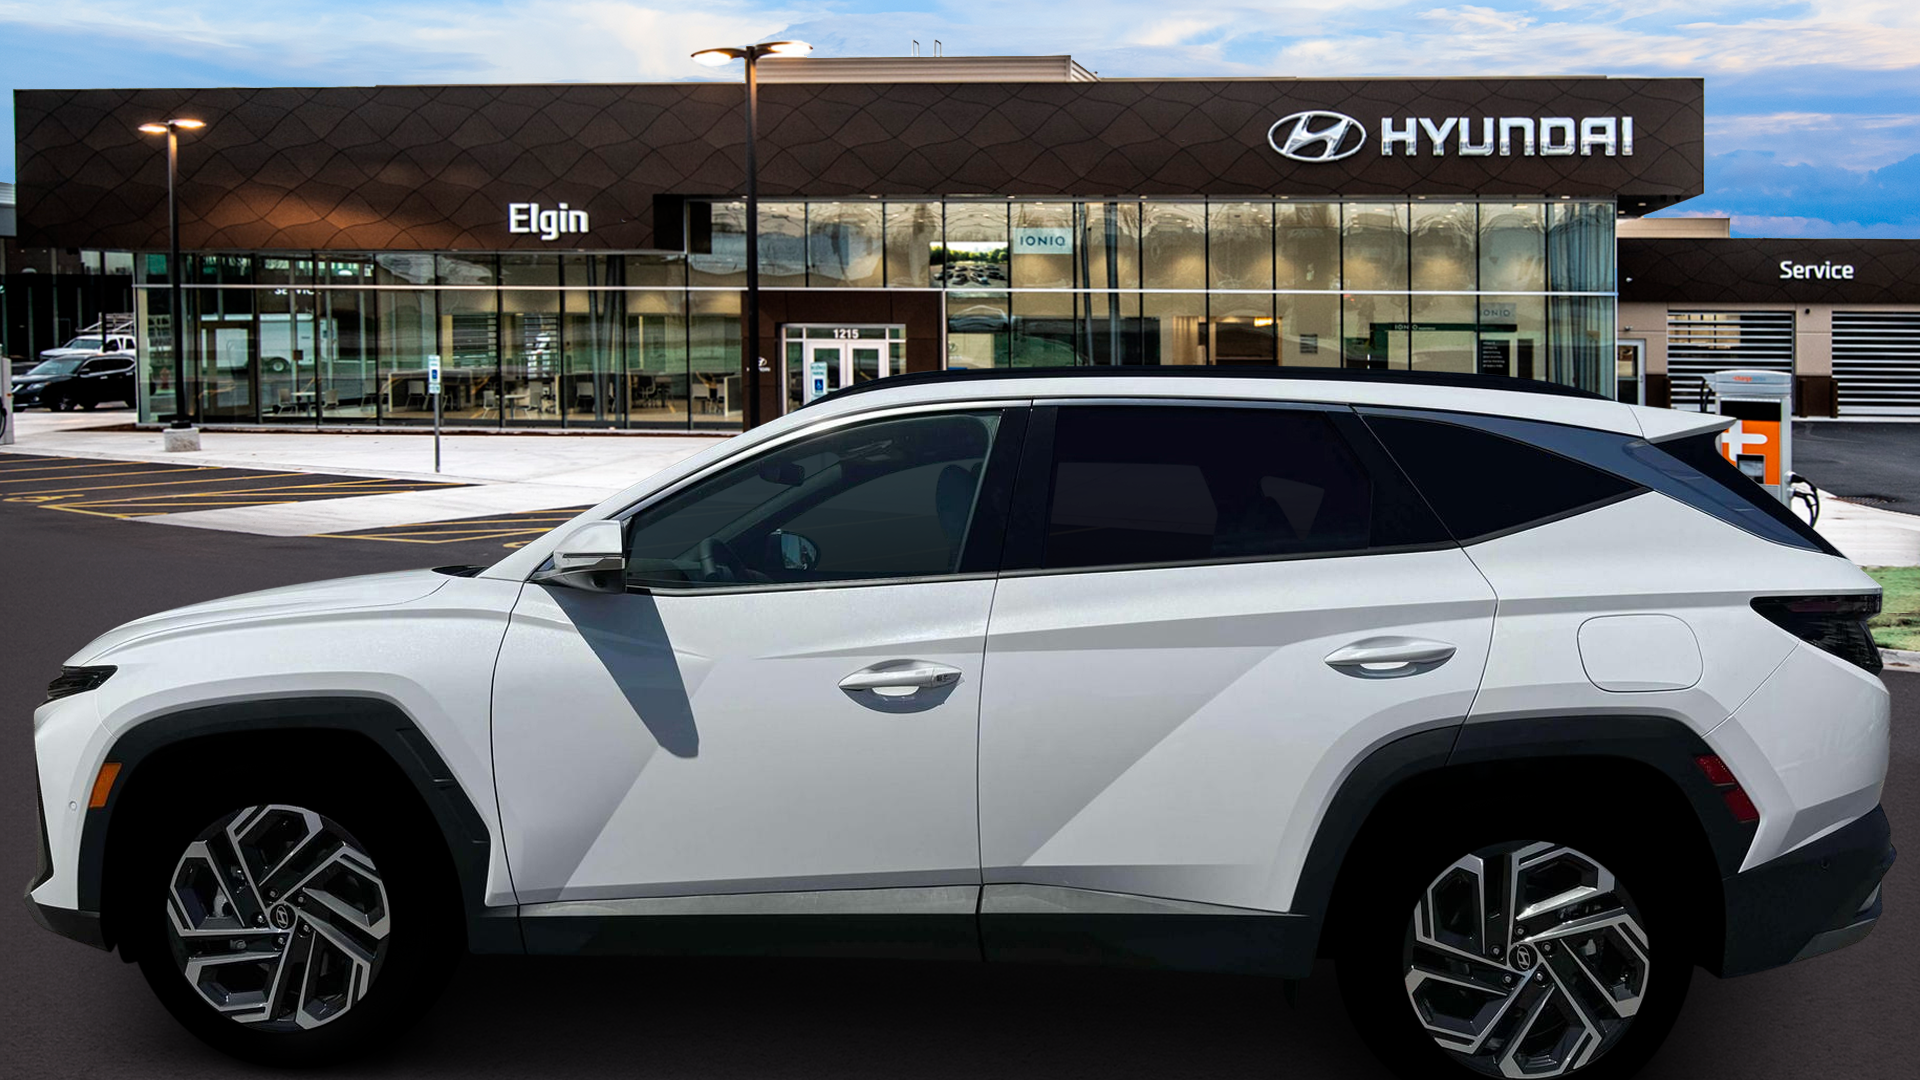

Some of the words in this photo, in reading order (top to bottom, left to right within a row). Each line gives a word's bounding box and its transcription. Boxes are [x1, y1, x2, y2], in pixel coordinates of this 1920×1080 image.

[1381, 117, 1634, 156] HYUNDAI
[509, 202, 590, 241] Elgin
[1020, 235, 1066, 247] IONIQ
[1779, 260, 1855, 280] Service
[833, 328, 859, 339] 1215
